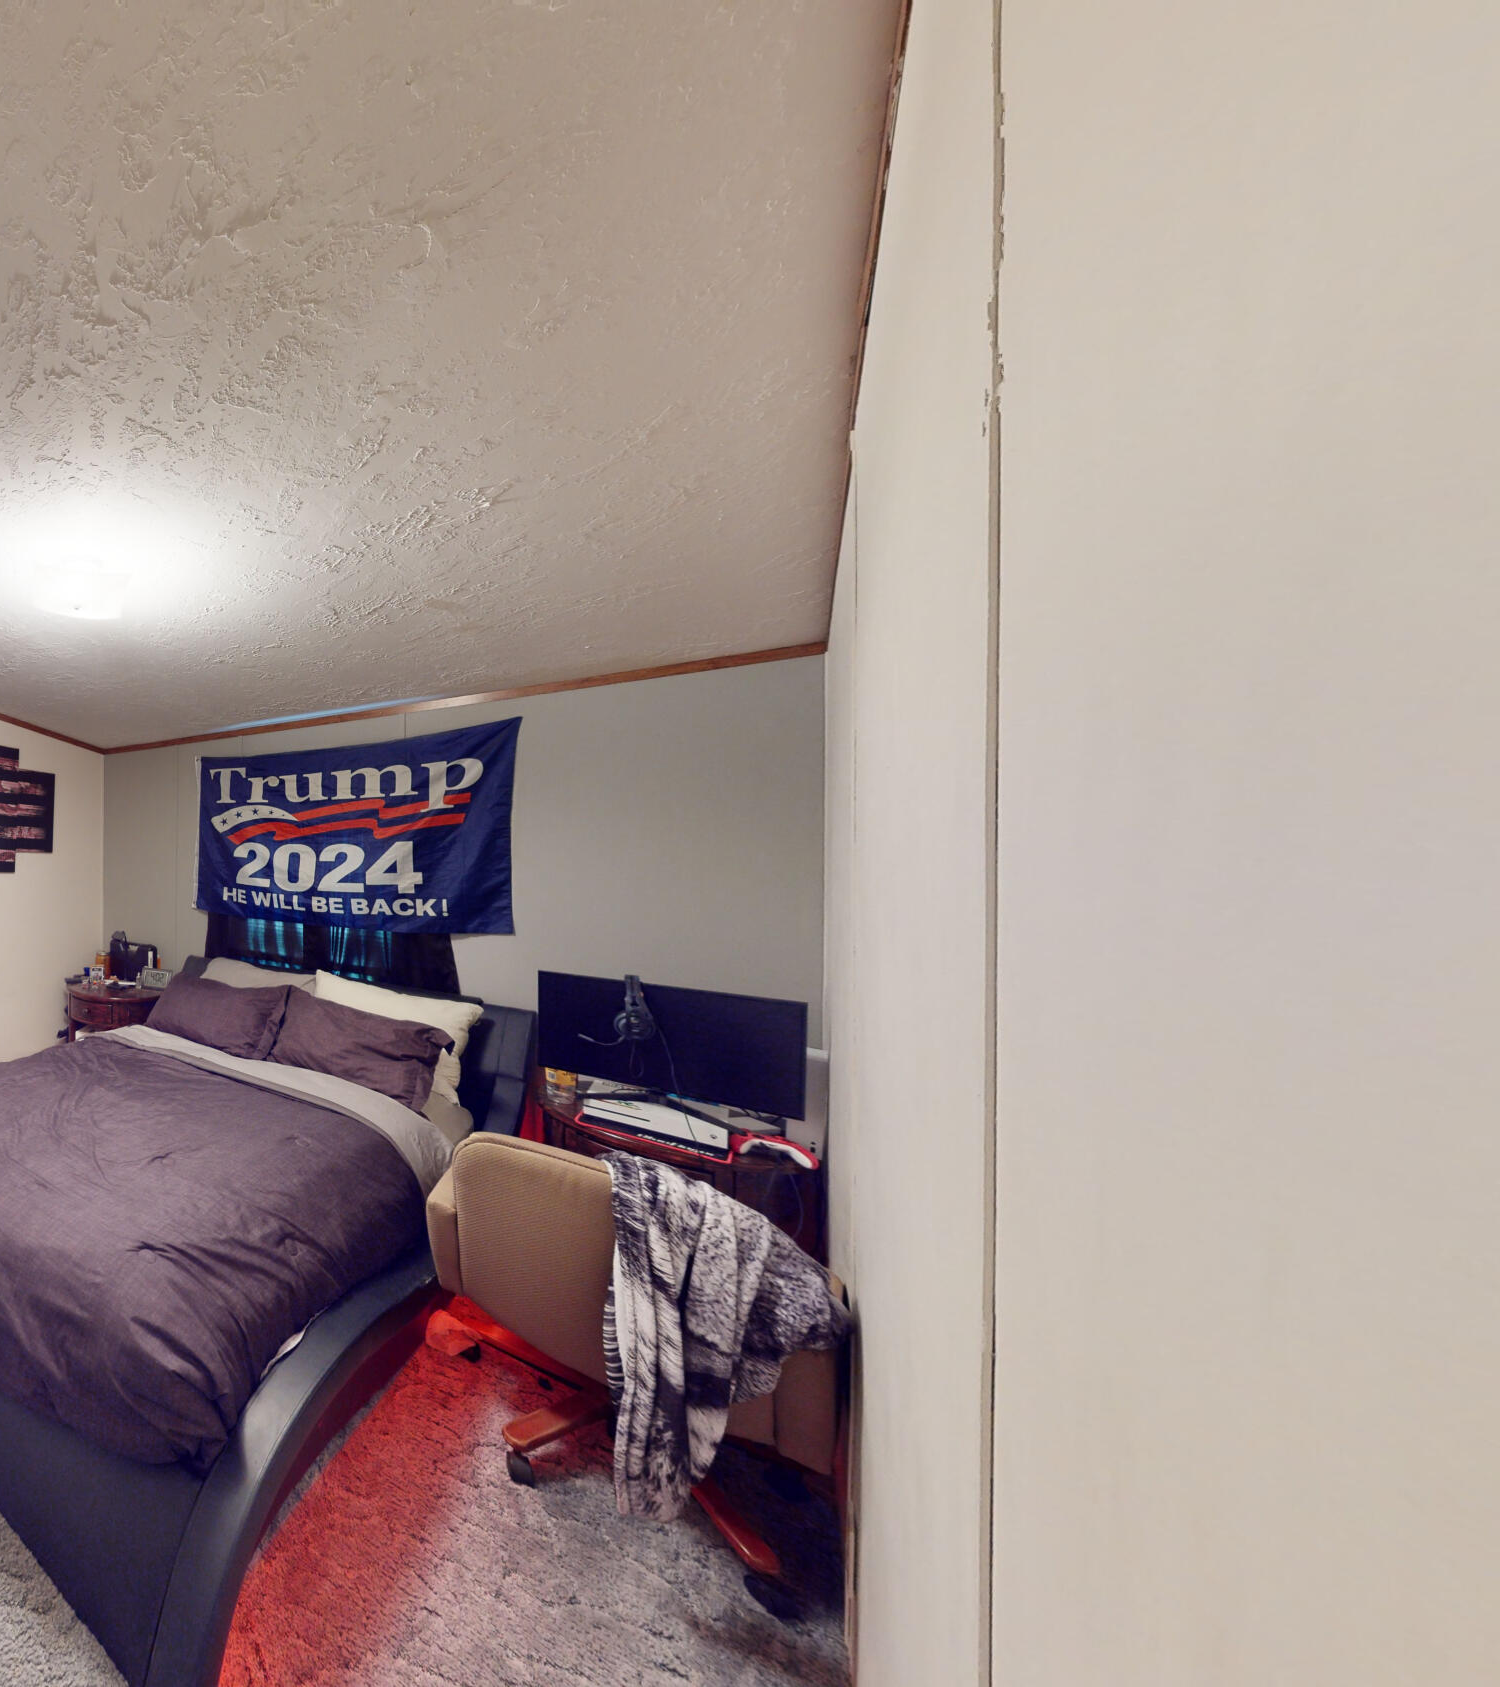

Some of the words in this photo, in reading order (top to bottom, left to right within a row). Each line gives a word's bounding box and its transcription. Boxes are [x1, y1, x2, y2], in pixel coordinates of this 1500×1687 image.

[210, 757, 484, 813] Trump
[233, 841, 424, 895] 2024
[222, 886, 247, 905] HE
[251, 891, 306, 912] WILL
[311, 896, 345, 915] BE
